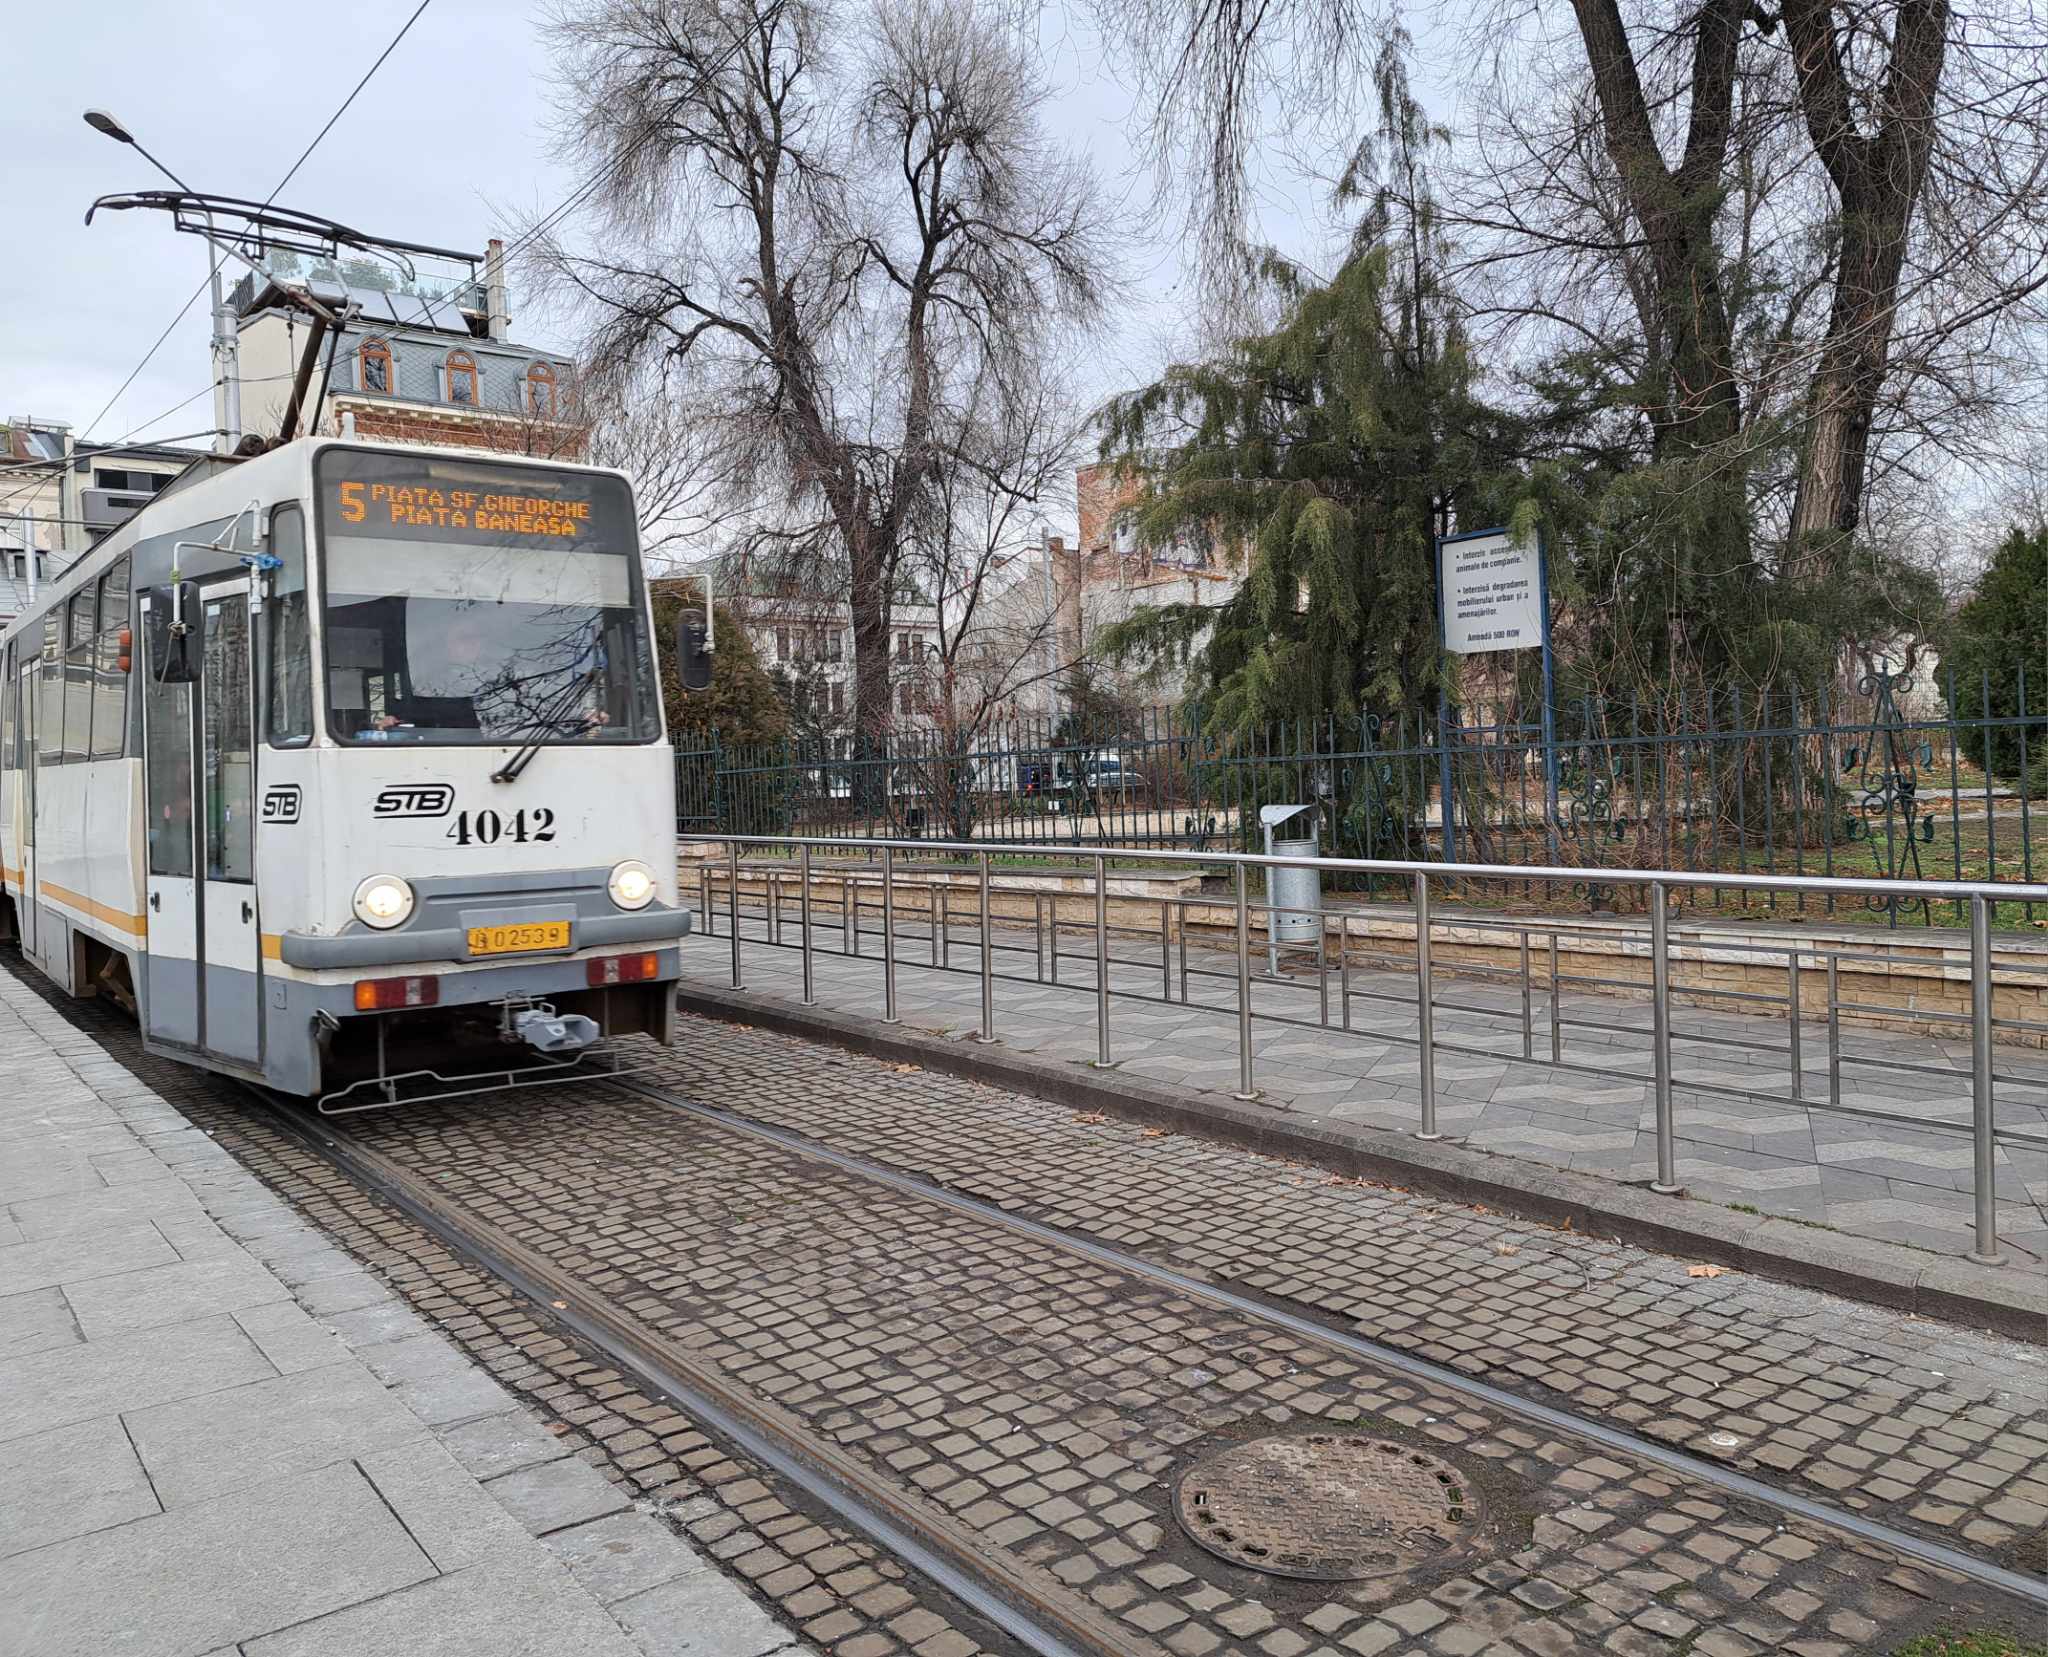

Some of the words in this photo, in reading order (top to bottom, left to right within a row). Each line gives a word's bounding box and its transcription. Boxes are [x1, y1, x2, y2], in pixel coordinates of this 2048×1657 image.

[341, 482, 366, 522] 5
[371, 484, 445, 506] PIATA
[391, 503, 468, 528] PIATA
[475, 510, 577, 536] BANEASA
[1456, 561, 1480, 573] animale
[1481, 560, 1489, 569] de
[1492, 580, 1528, 592] degradarea
[1457, 594, 1494, 607] mobilierului
[1496, 594, 1514, 602] urban
[262, 792, 298, 817] STB
[373, 790, 448, 813] STB
[446, 807, 556, 846] 4042
